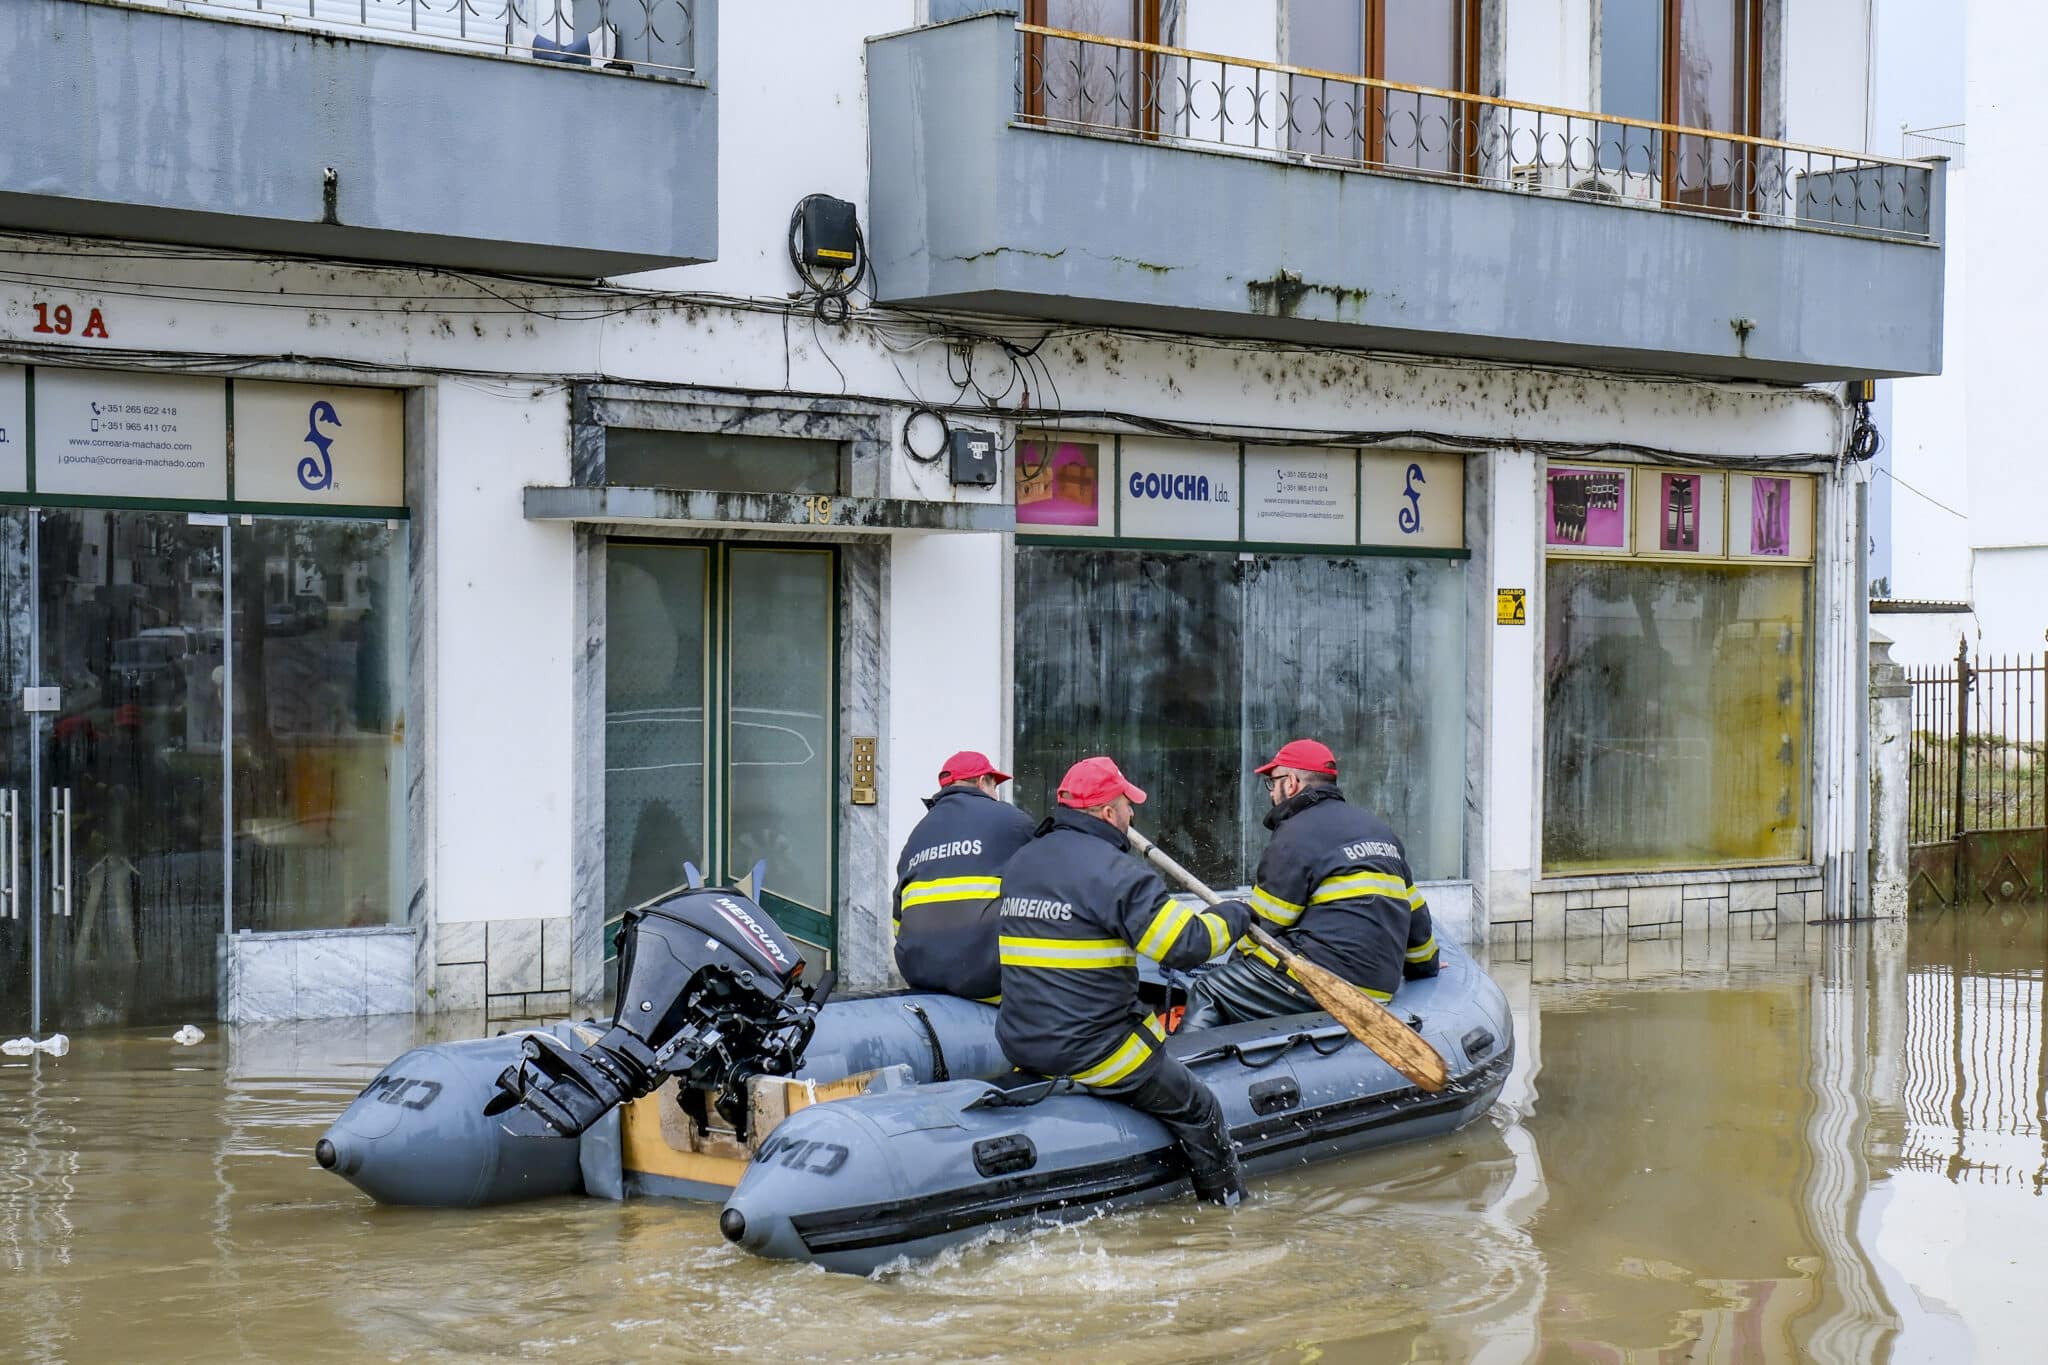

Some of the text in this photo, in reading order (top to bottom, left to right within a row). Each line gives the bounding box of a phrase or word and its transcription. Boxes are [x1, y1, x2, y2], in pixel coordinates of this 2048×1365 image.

[33, 302, 109, 339] 19 A
[101, 404, 177, 416] +351 265 622 418
[101, 421, 177, 433] +351 965 411 074
[69, 437, 193, 451] www.correaria-machado.com
[806, 496, 832, 525] 19
[715, 898, 790, 965] MERCURY
